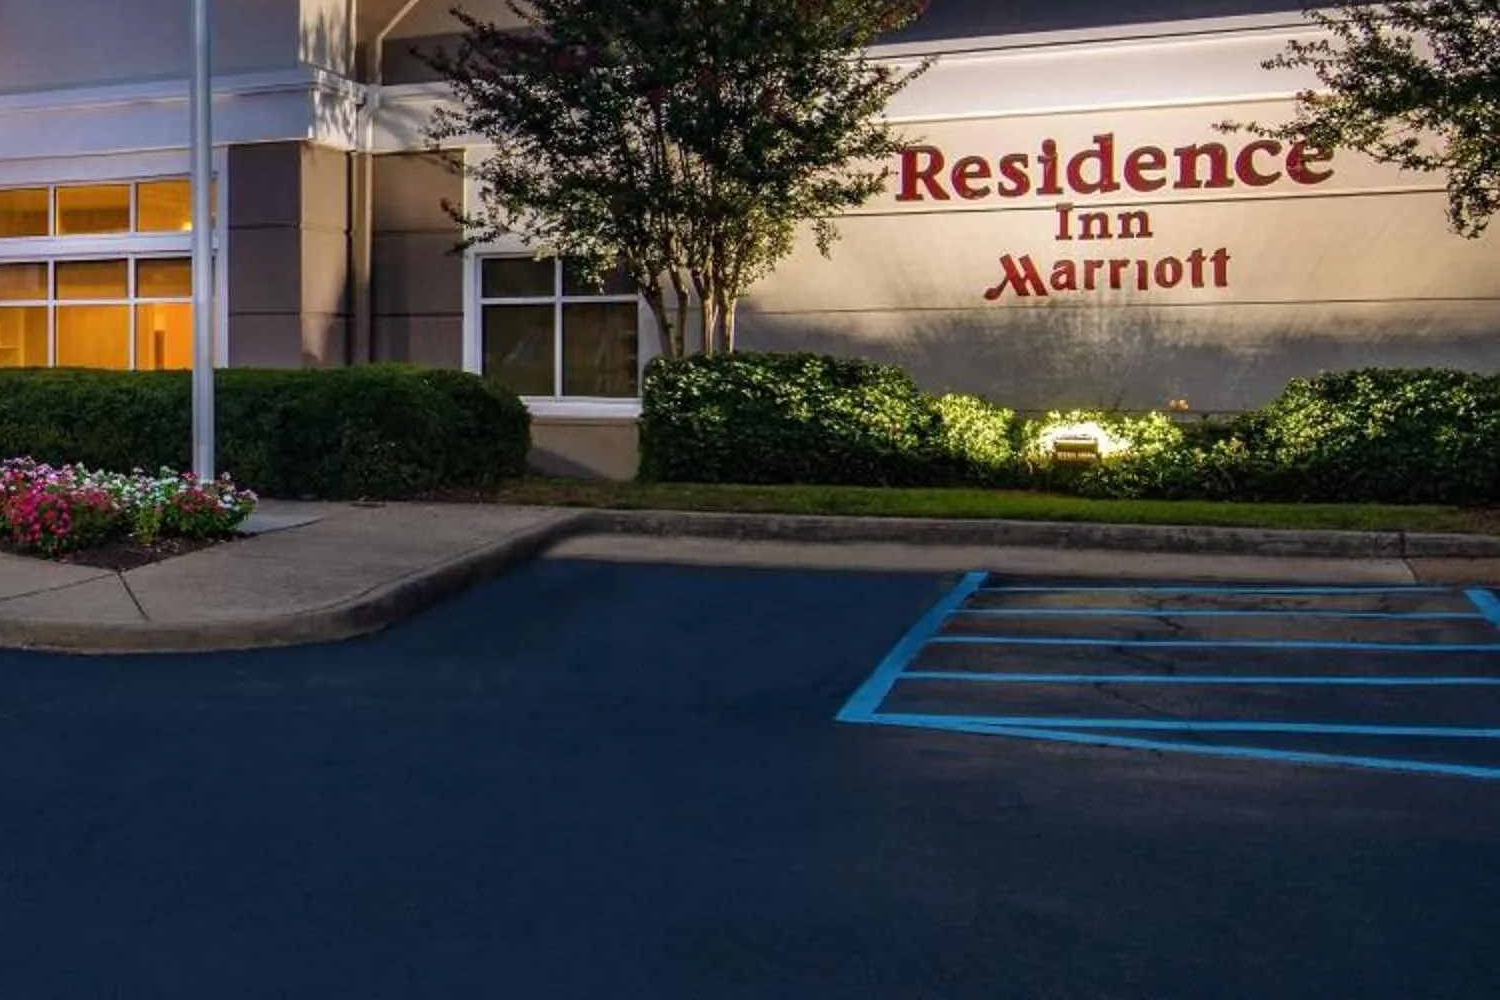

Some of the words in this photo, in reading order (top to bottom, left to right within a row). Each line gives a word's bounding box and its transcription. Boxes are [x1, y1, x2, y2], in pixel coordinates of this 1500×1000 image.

[896, 133, 1334, 201] Residence
[1055, 203, 1153, 240] Inn
[984, 247, 1231, 300] Marriott
